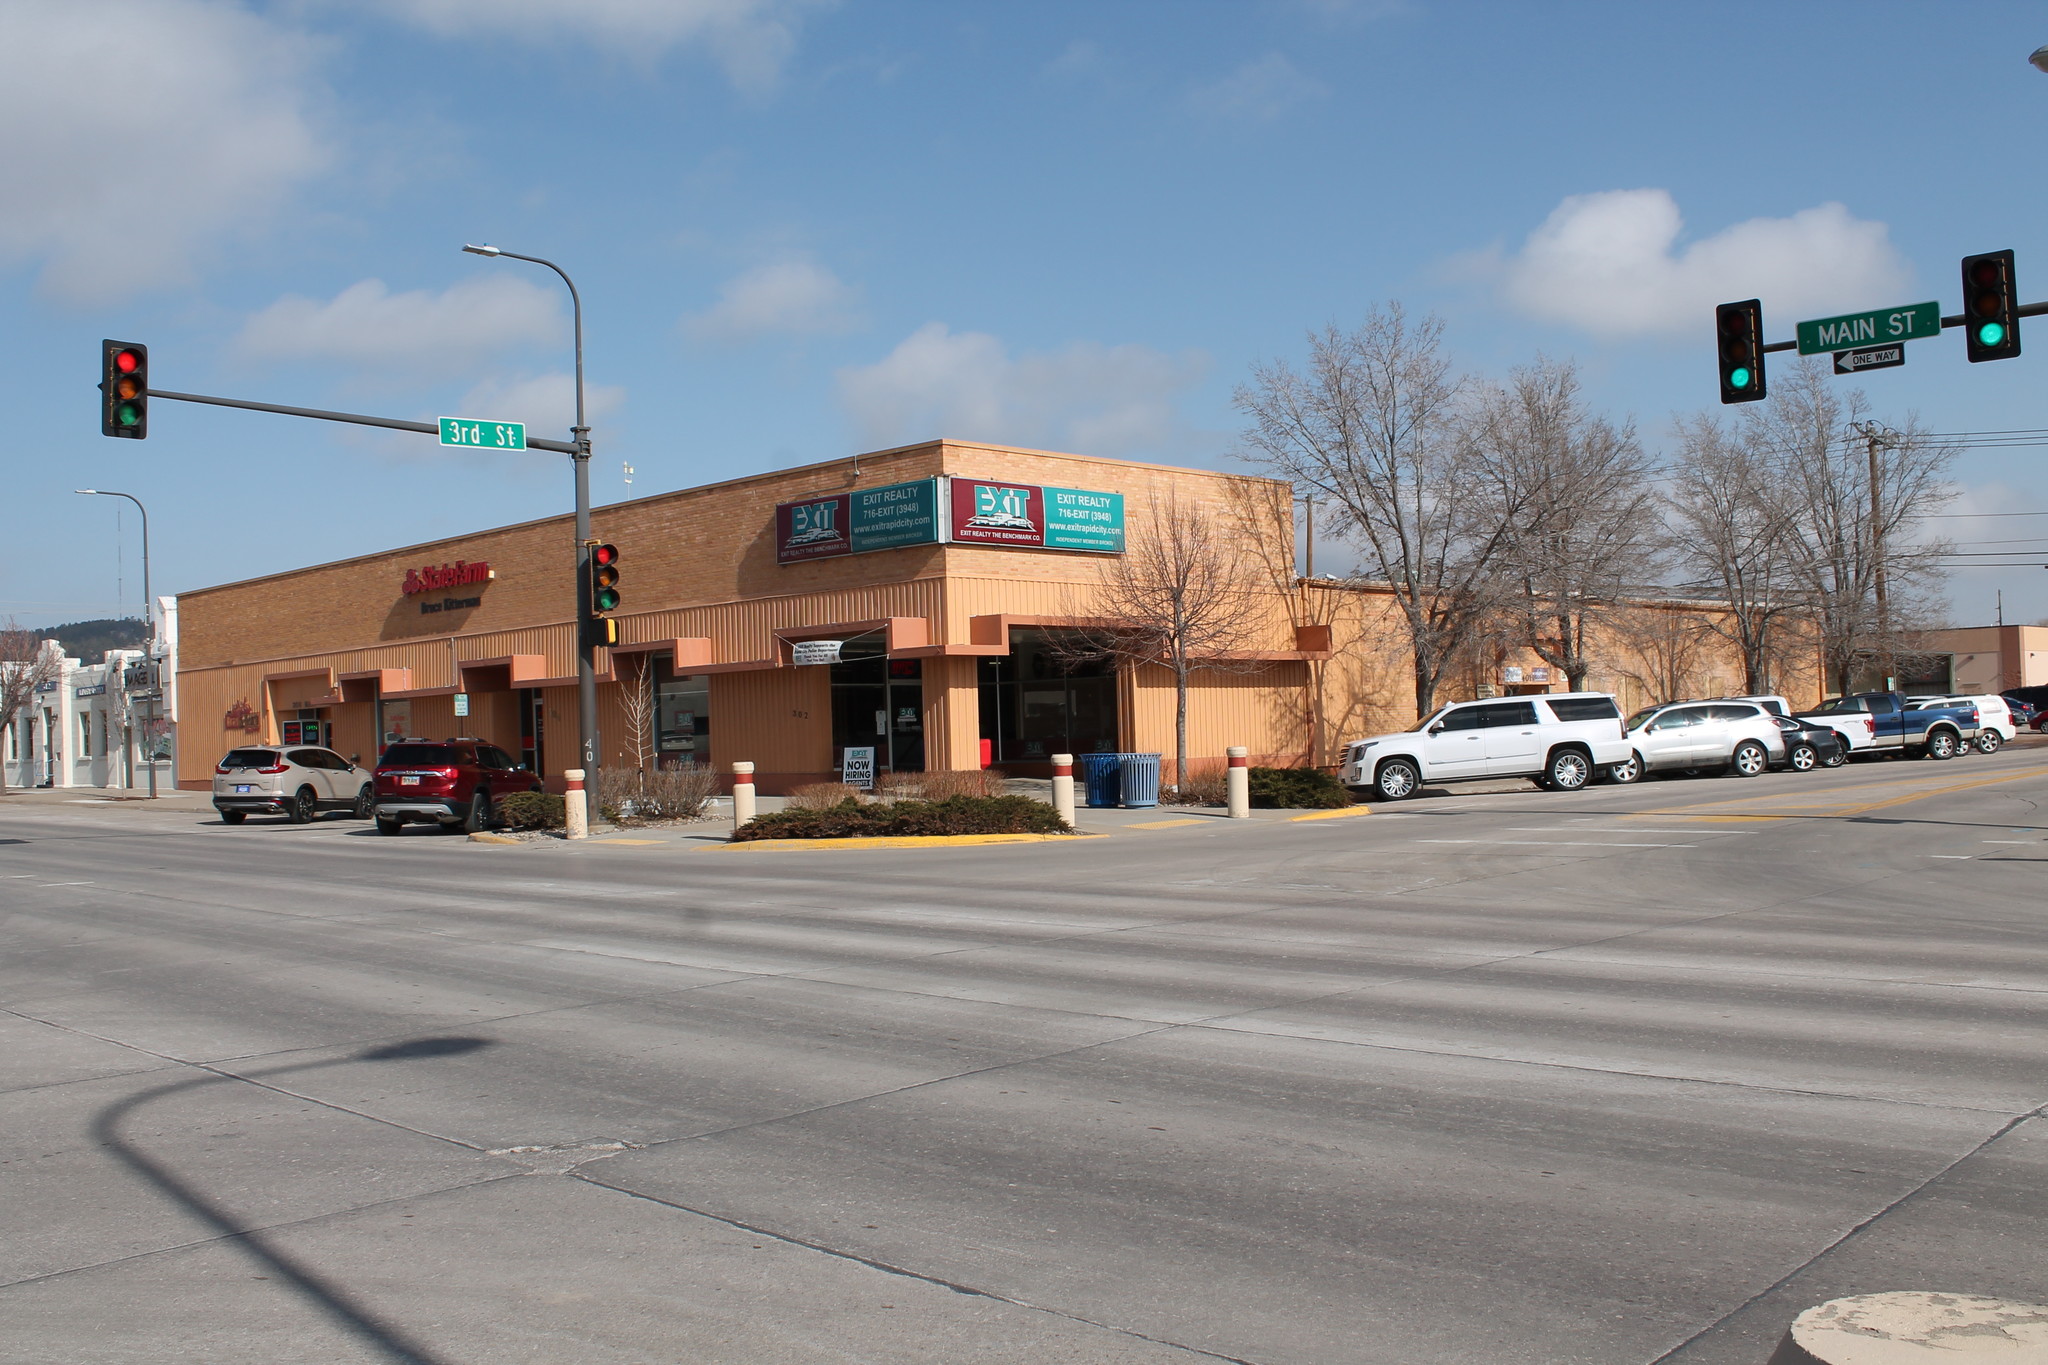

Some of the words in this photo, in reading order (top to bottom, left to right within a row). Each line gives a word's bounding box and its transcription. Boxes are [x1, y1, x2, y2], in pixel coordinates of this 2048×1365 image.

[1818, 317, 1874, 346] MAIN
[1889, 310, 1916, 336] ST
[1852, 354, 1872, 365] ONE
[1875, 350, 1896, 362] WAY
[449, 422, 480, 444] 3rd
[496, 425, 514, 446] St
[864, 493, 882, 506] EXIT
[884, 487, 918, 502] REALTY
[1057, 493, 1076, 505] EXIT
[1078, 495, 1110, 508] REALTY
[864, 506, 894, 519] 716-EXIT
[896, 502, 919, 516] (3948)
[1058, 508, 1089, 520] 716-EXIT
[1091, 511, 1112, 523] (3948)
[854, 516, 930, 534] www.exitrapidcity.com
[1049, 522, 1121, 536] www.exitrapidcity.com
[790, 548, 805, 556] REALTY
[814, 545, 840, 553] BENCHMARK
[792, 710, 808, 719] 302
[585, 738, 593, 762] 40
[847, 761, 870, 770] NOW
[845, 771, 871, 779] HIRING
